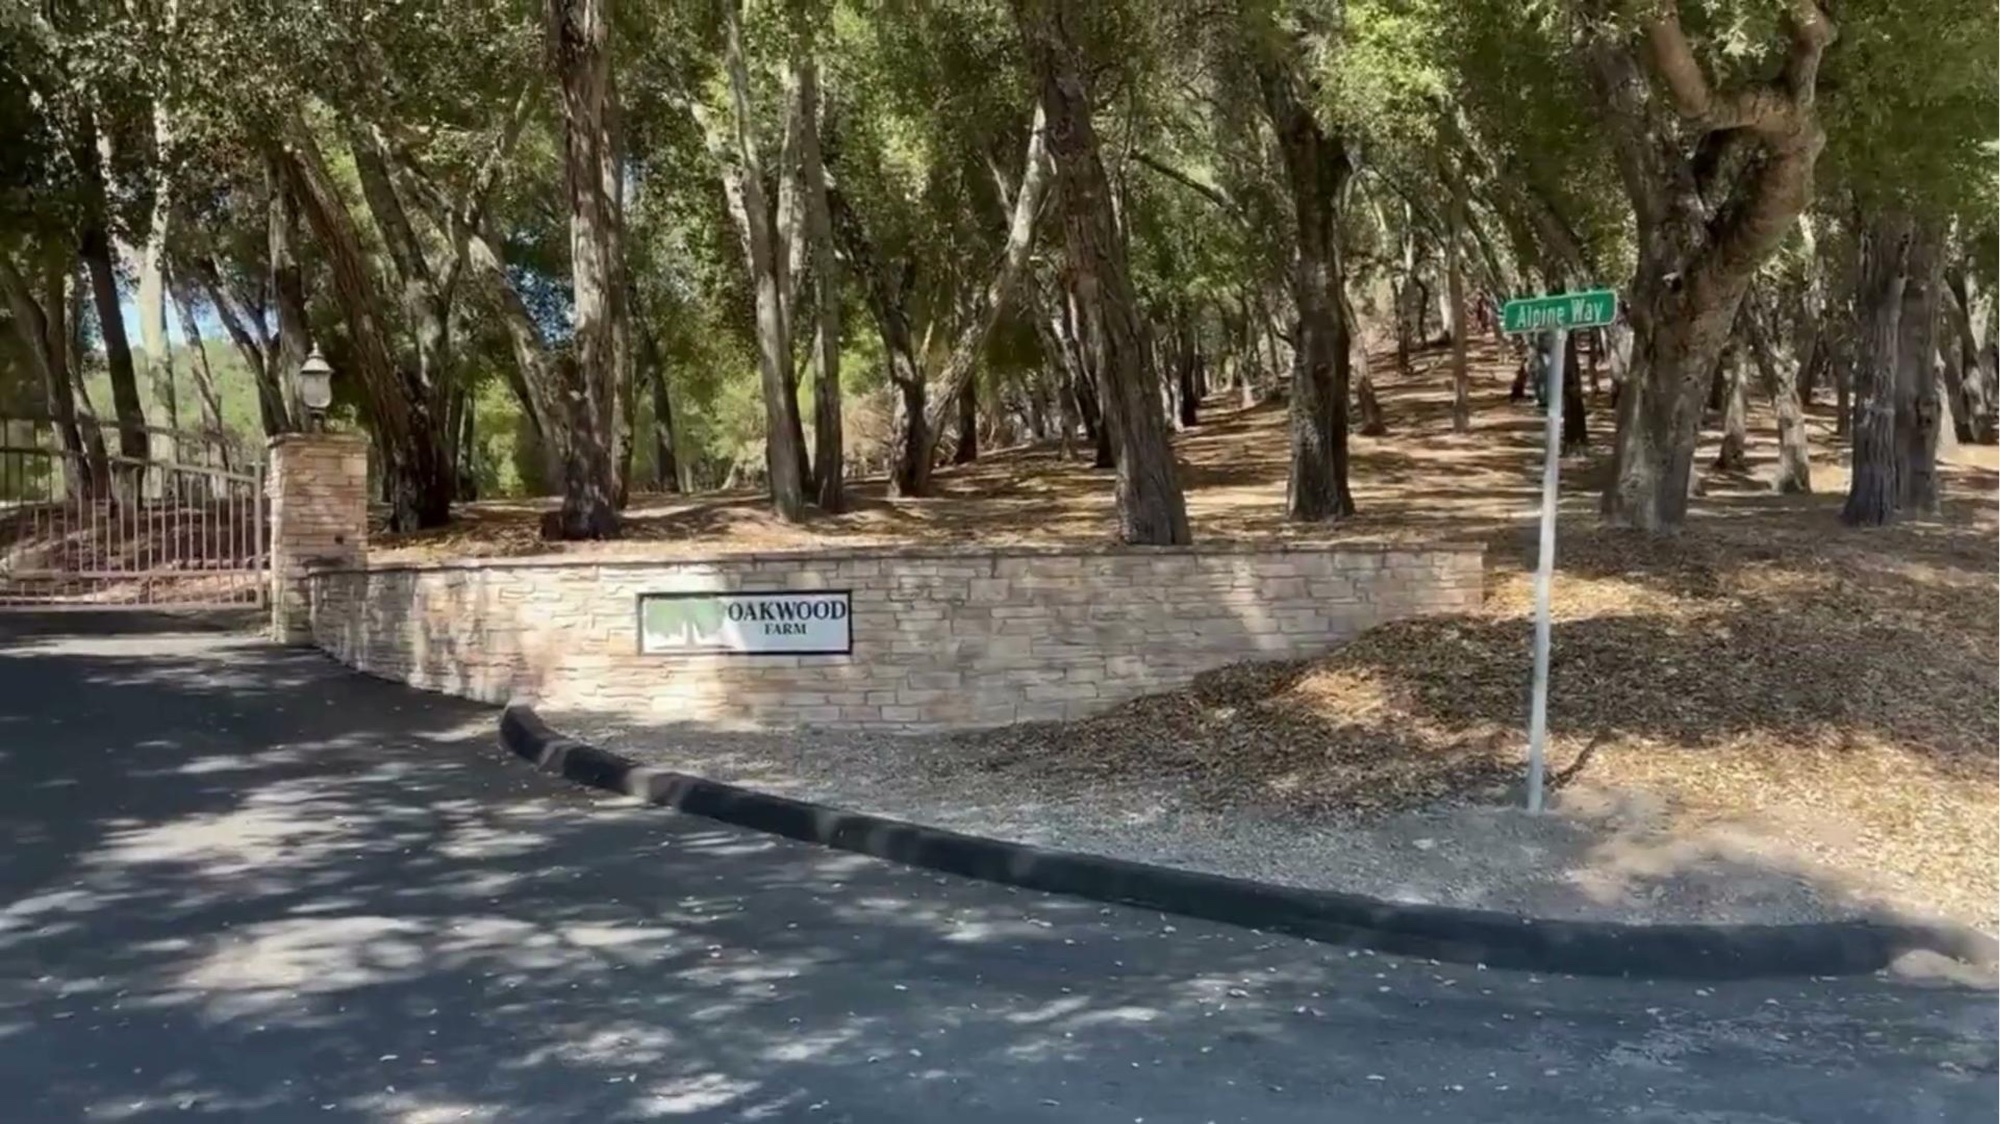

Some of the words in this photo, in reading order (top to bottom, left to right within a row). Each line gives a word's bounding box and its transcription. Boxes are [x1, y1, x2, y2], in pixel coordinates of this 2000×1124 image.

[1516, 305, 1565, 329] Alpine
[1570, 299, 1604, 324] Way
[728, 600, 847, 621] OAKWOOD
[764, 623, 808, 635] FARM
